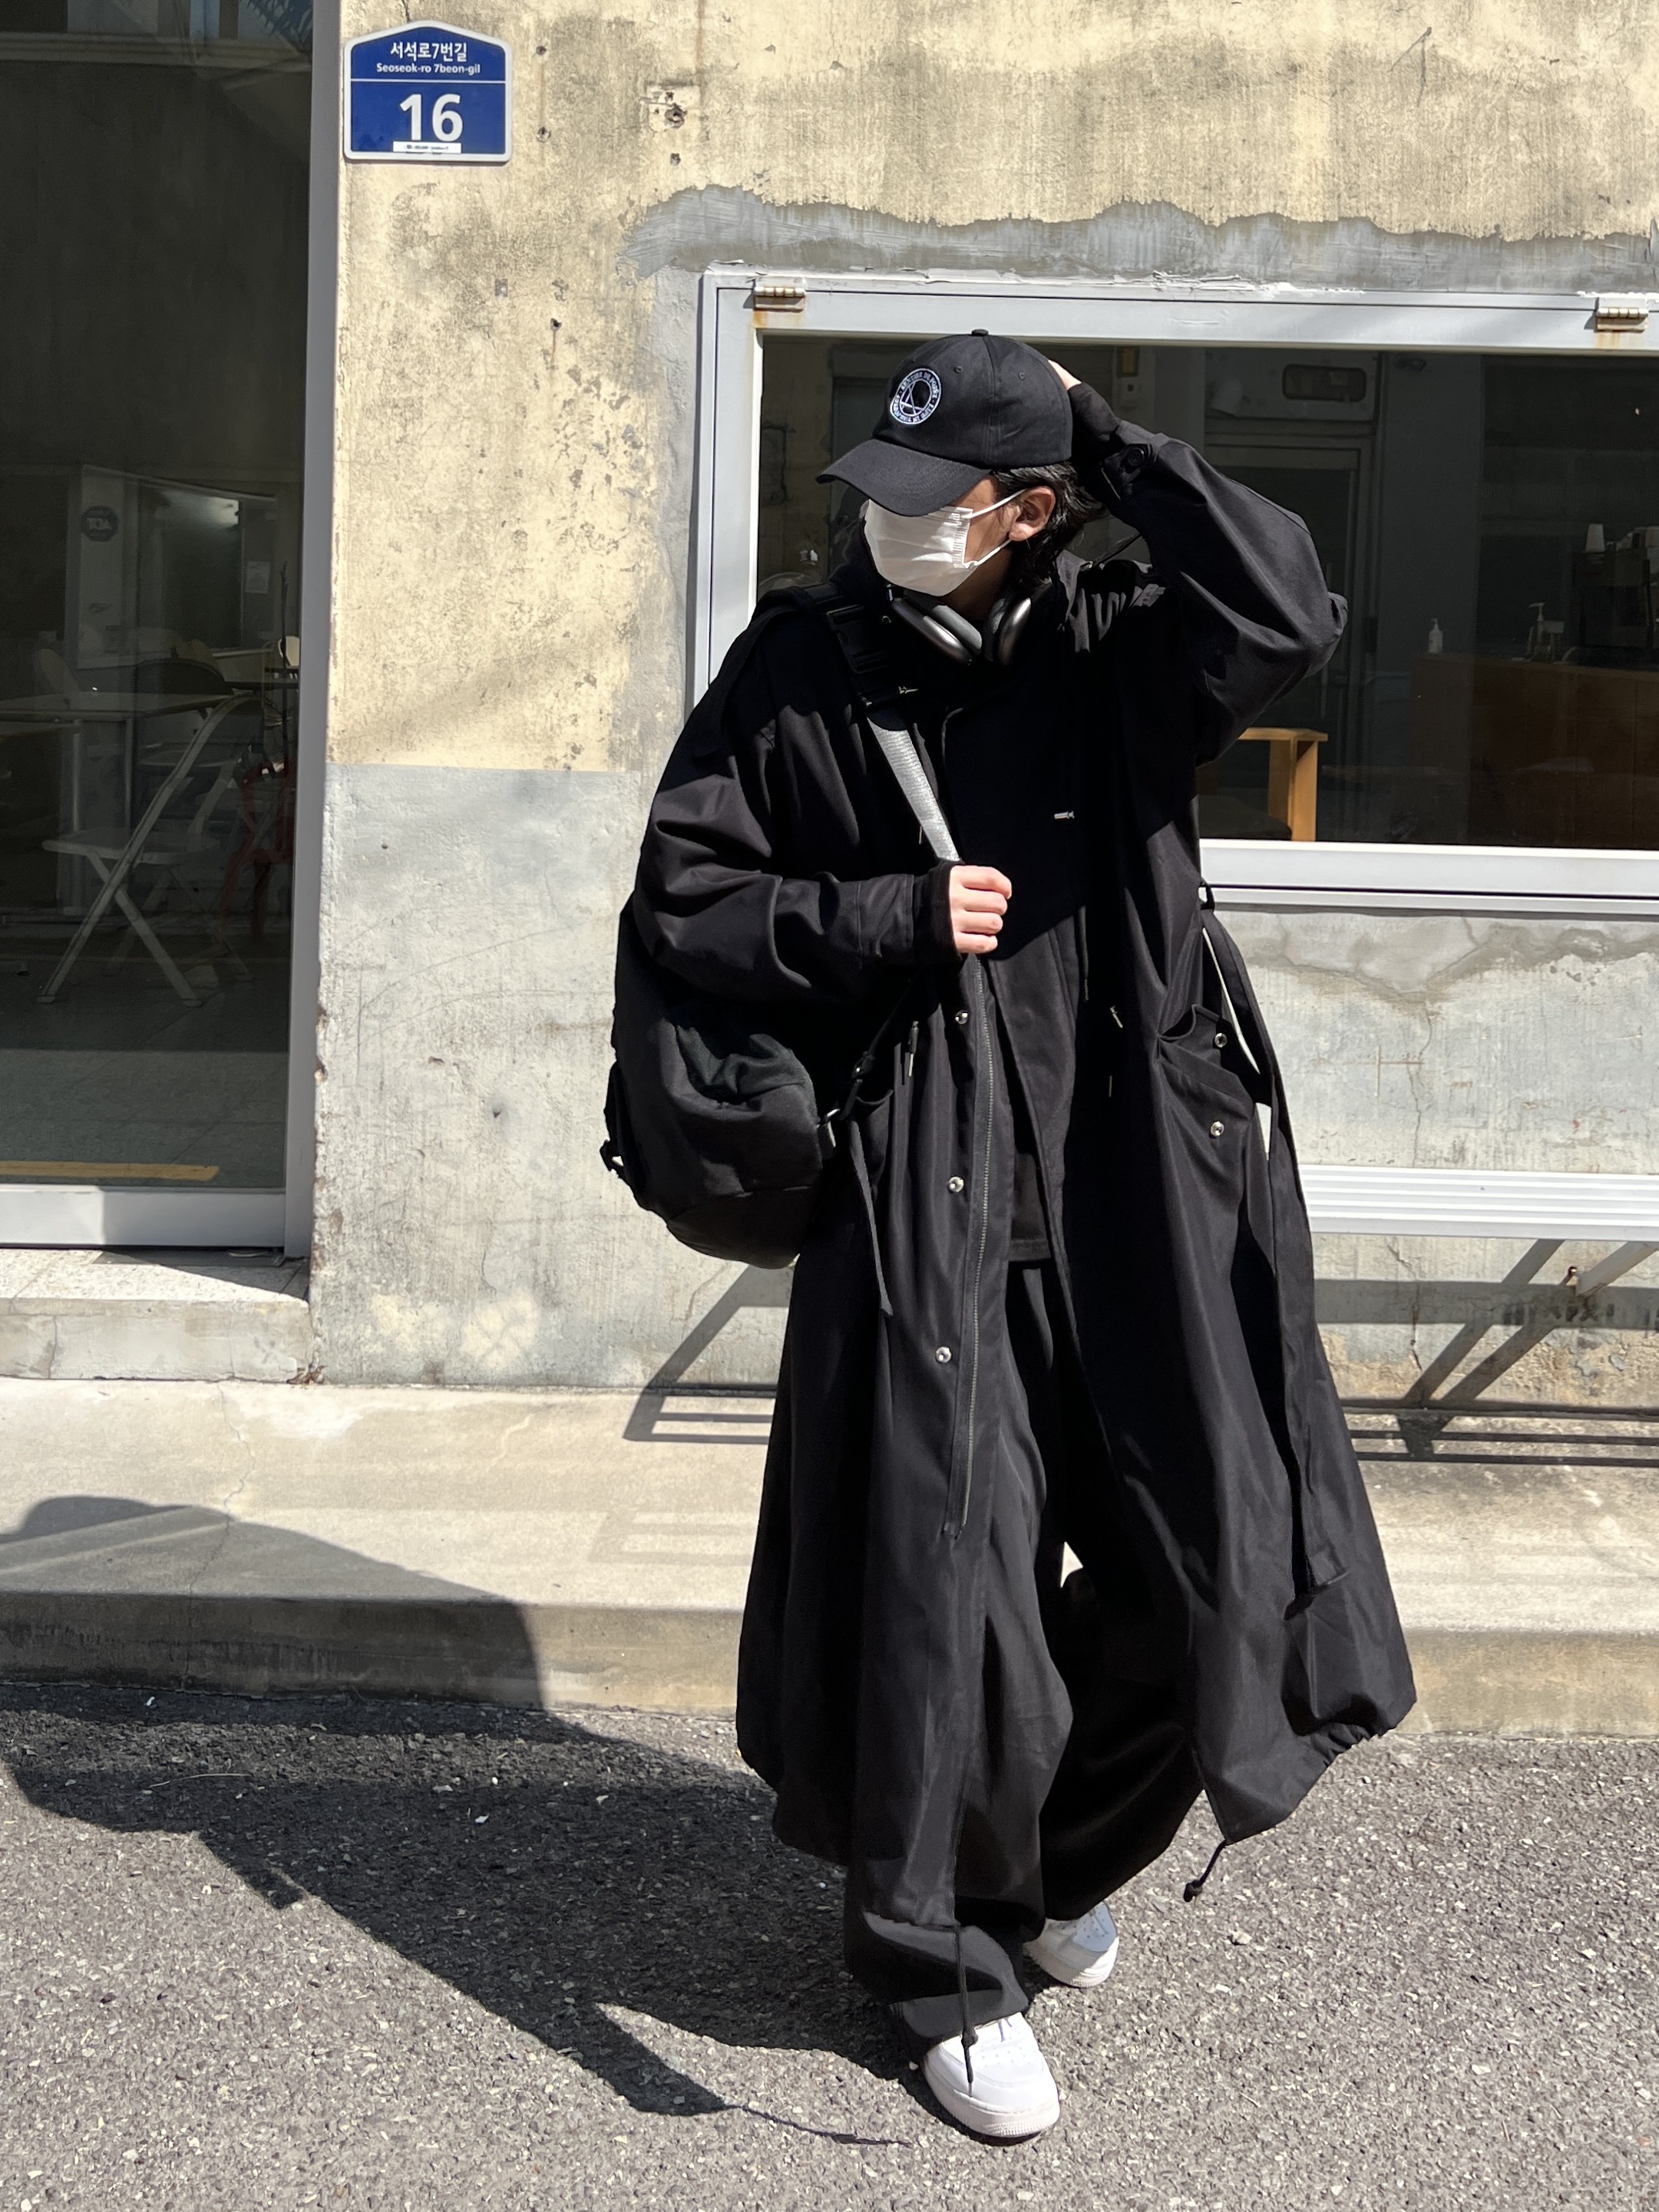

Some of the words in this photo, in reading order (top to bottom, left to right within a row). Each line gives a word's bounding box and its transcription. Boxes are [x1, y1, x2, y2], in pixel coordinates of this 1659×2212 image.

[390, 41, 467, 62] 서석로7번길
[376, 63, 431, 73] Seoseok-ro
[434, 63, 481, 76] 7beon-gil
[400, 94, 463, 142] 16
